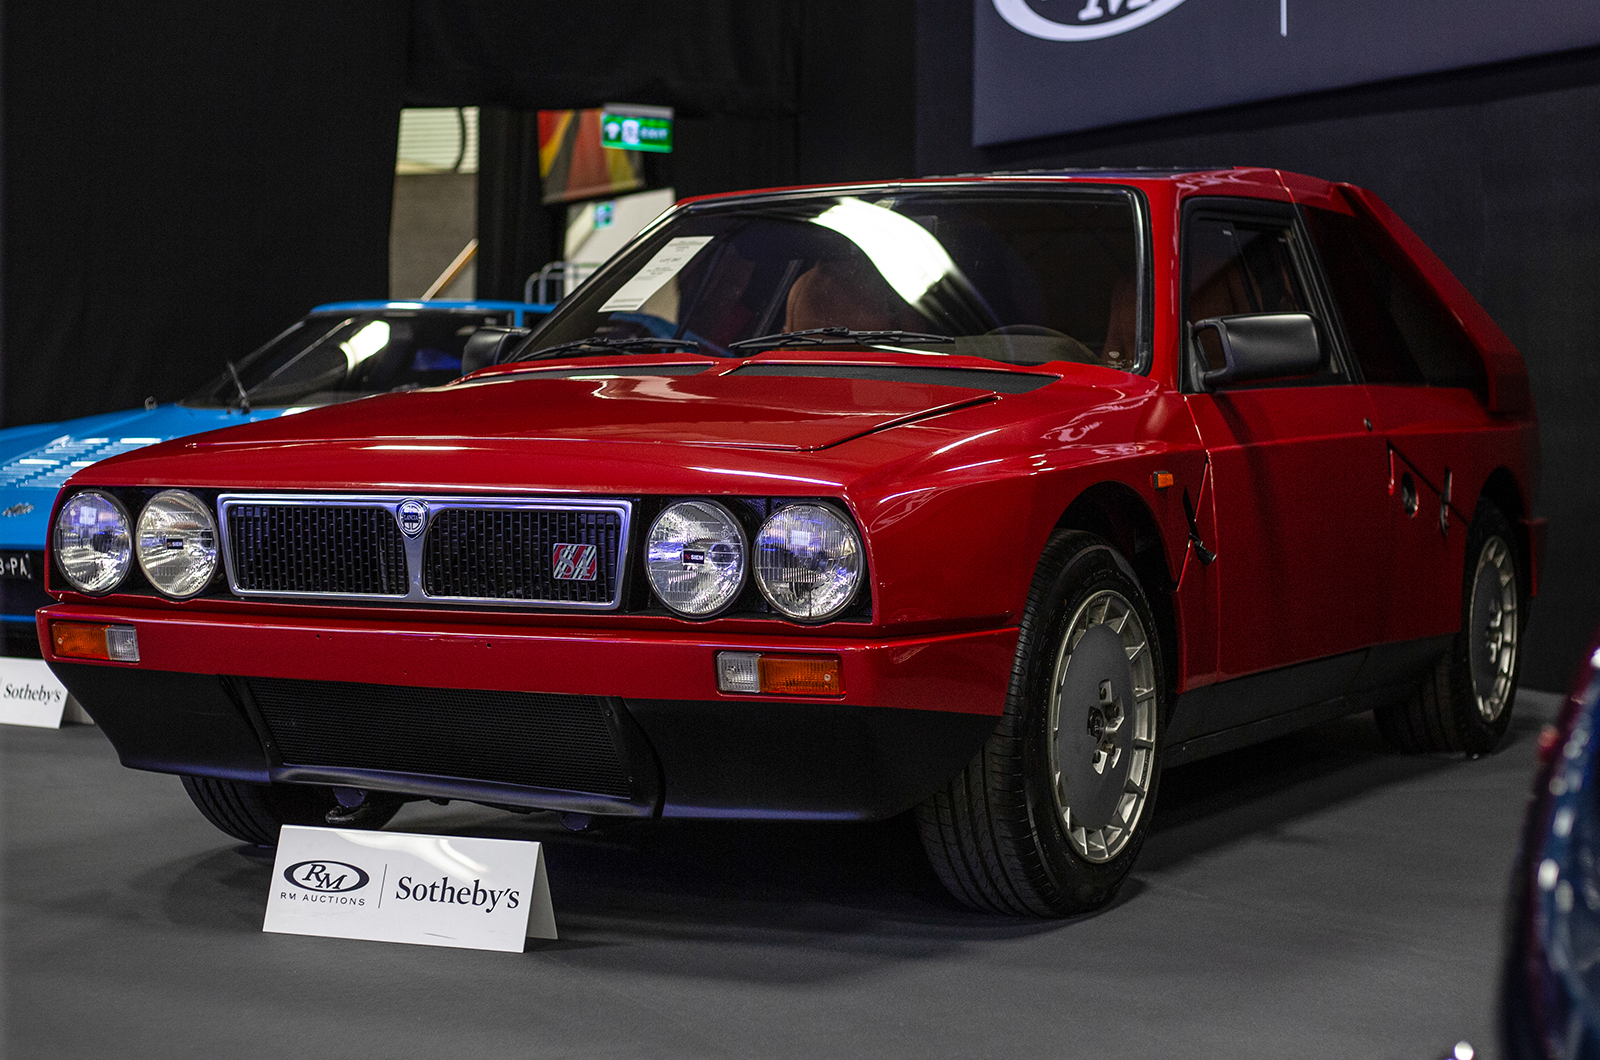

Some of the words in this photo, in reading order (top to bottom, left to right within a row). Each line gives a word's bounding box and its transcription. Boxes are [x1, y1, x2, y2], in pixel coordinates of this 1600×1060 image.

[558, 547, 591, 576] S4
[3, 683, 62, 706] Sotheby's
[301, 863, 348, 890] RM
[280, 891, 296, 901] RM
[302, 893, 366, 907] AUCTIONS
[395, 876, 521, 914] Sotheby's
